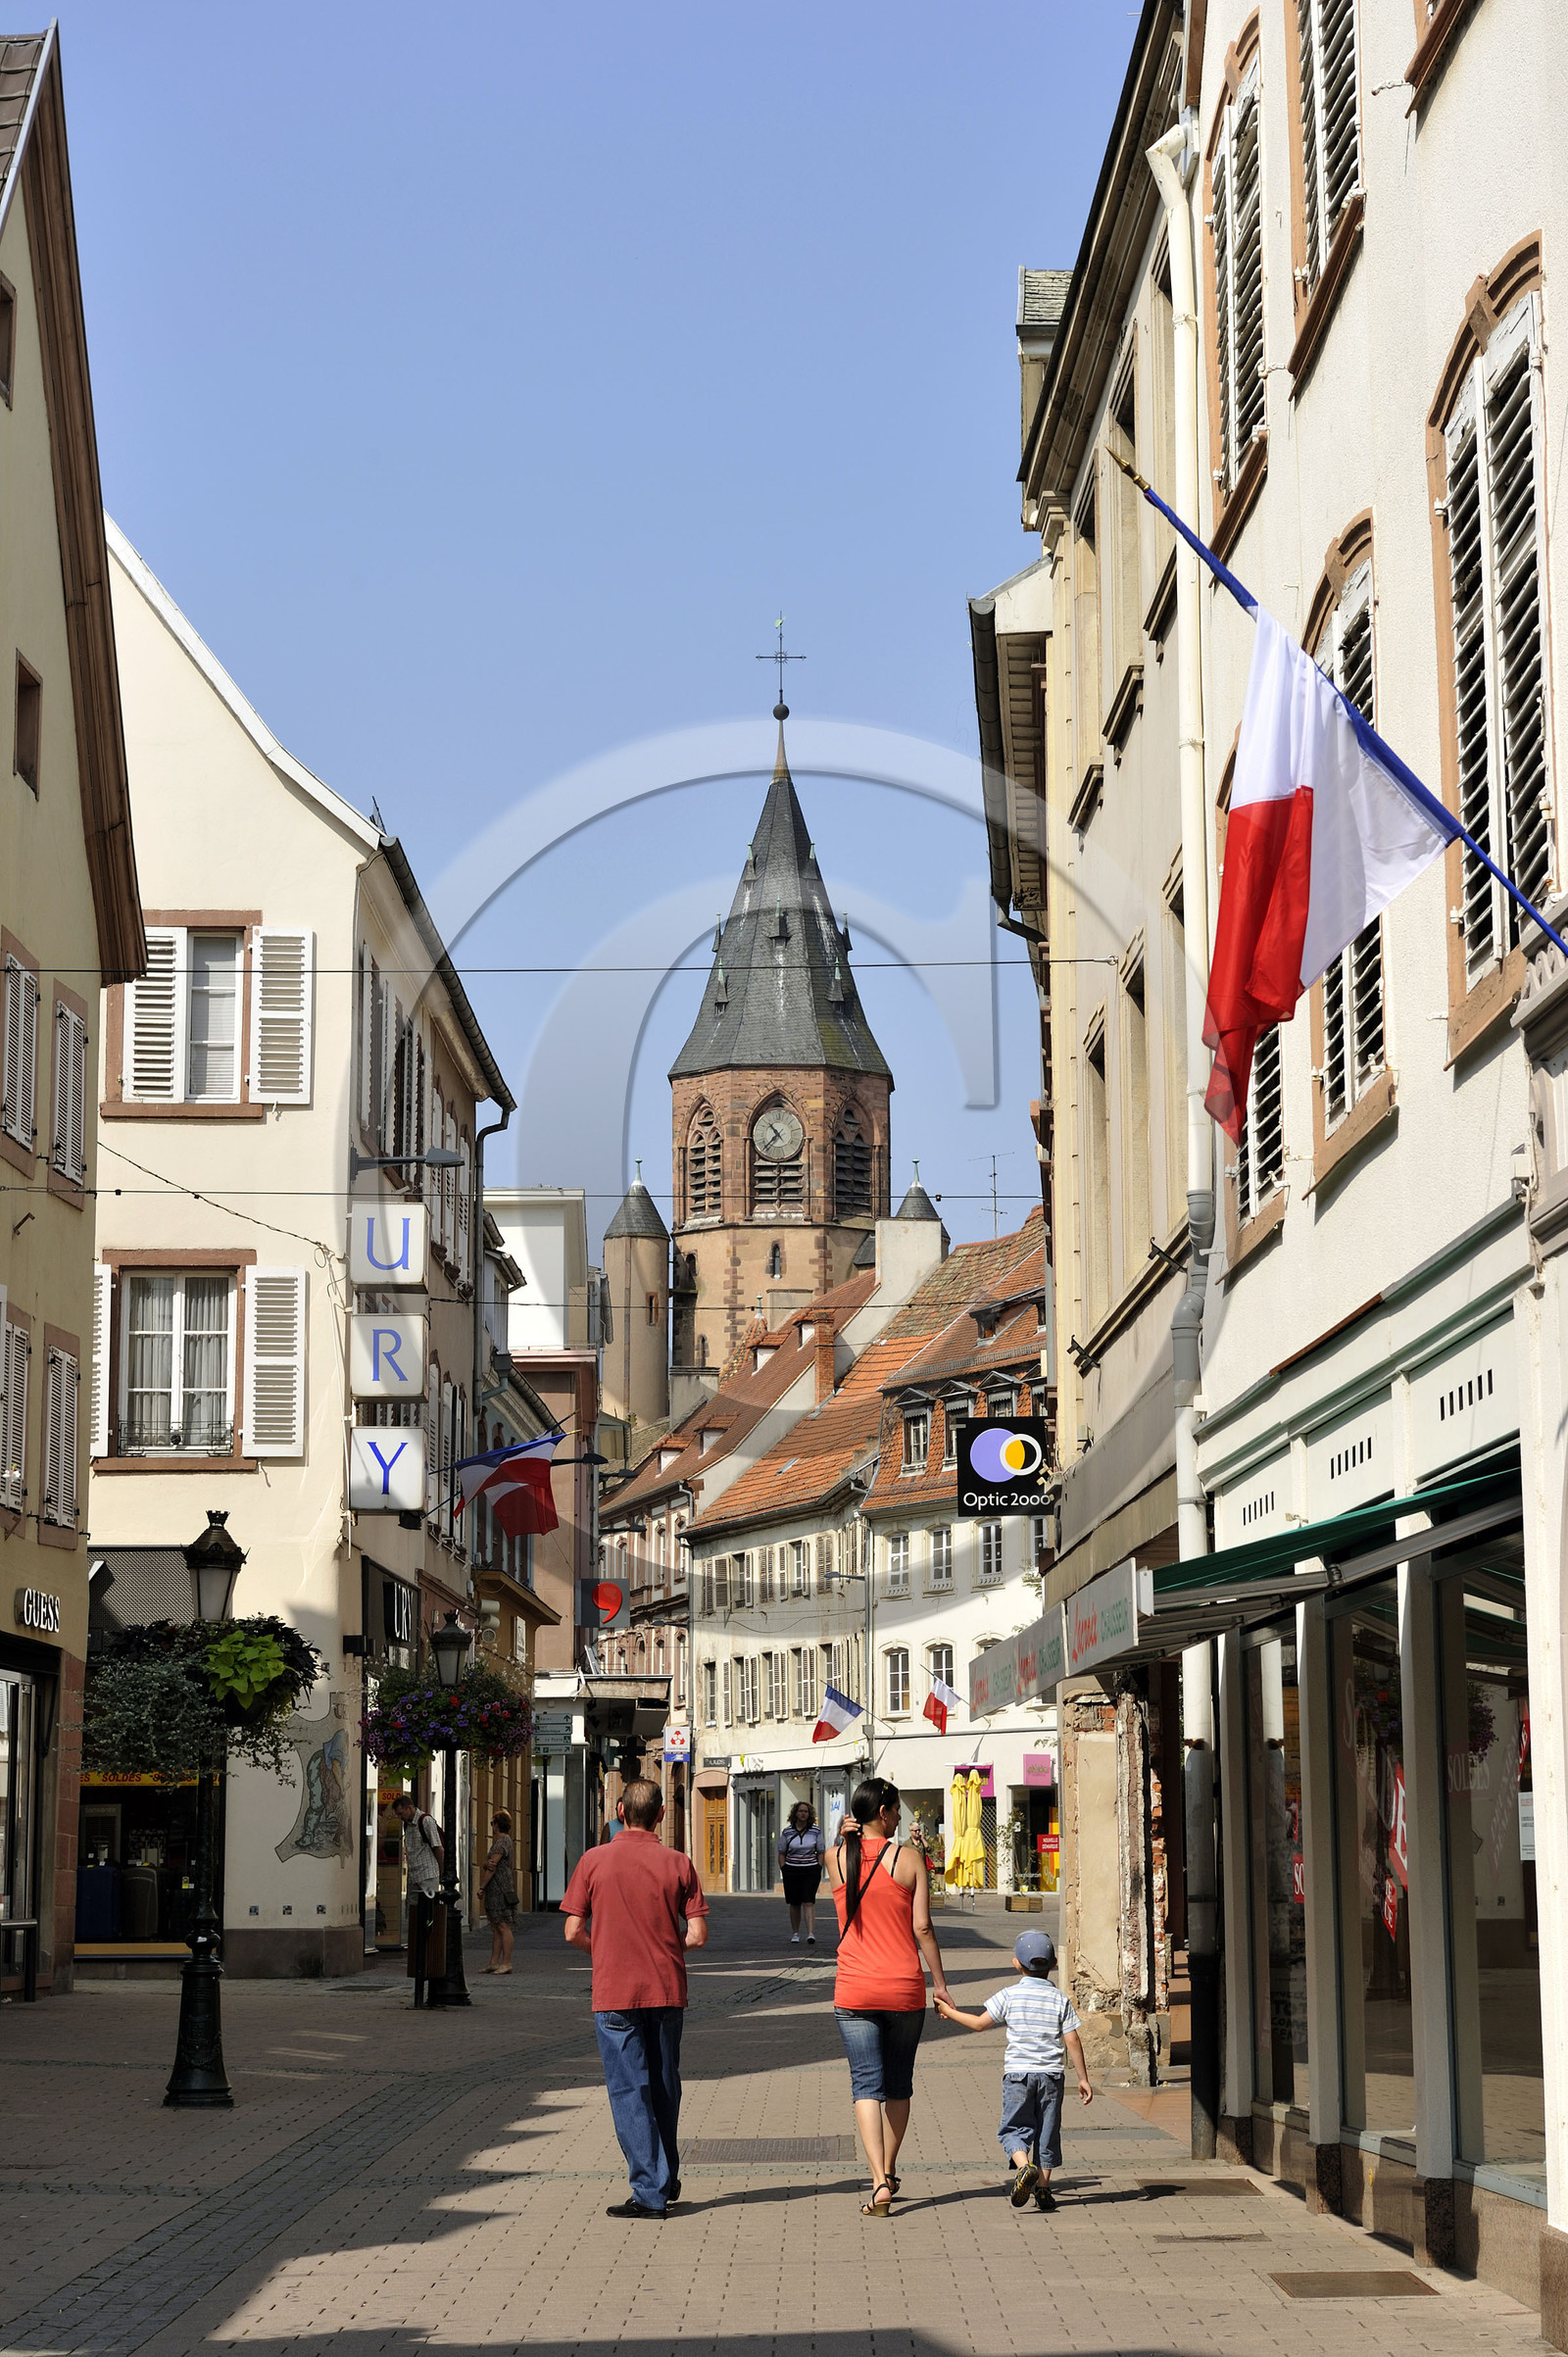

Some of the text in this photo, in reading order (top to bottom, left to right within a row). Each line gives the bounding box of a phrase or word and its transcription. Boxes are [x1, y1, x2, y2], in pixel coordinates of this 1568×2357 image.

[963, 1492, 1051, 1510] Optic 2000
[24, 1587, 61, 1633] GUESS
[394, 1582, 414, 1643] URY
[101, 1773, 142, 1783] SOLDES
